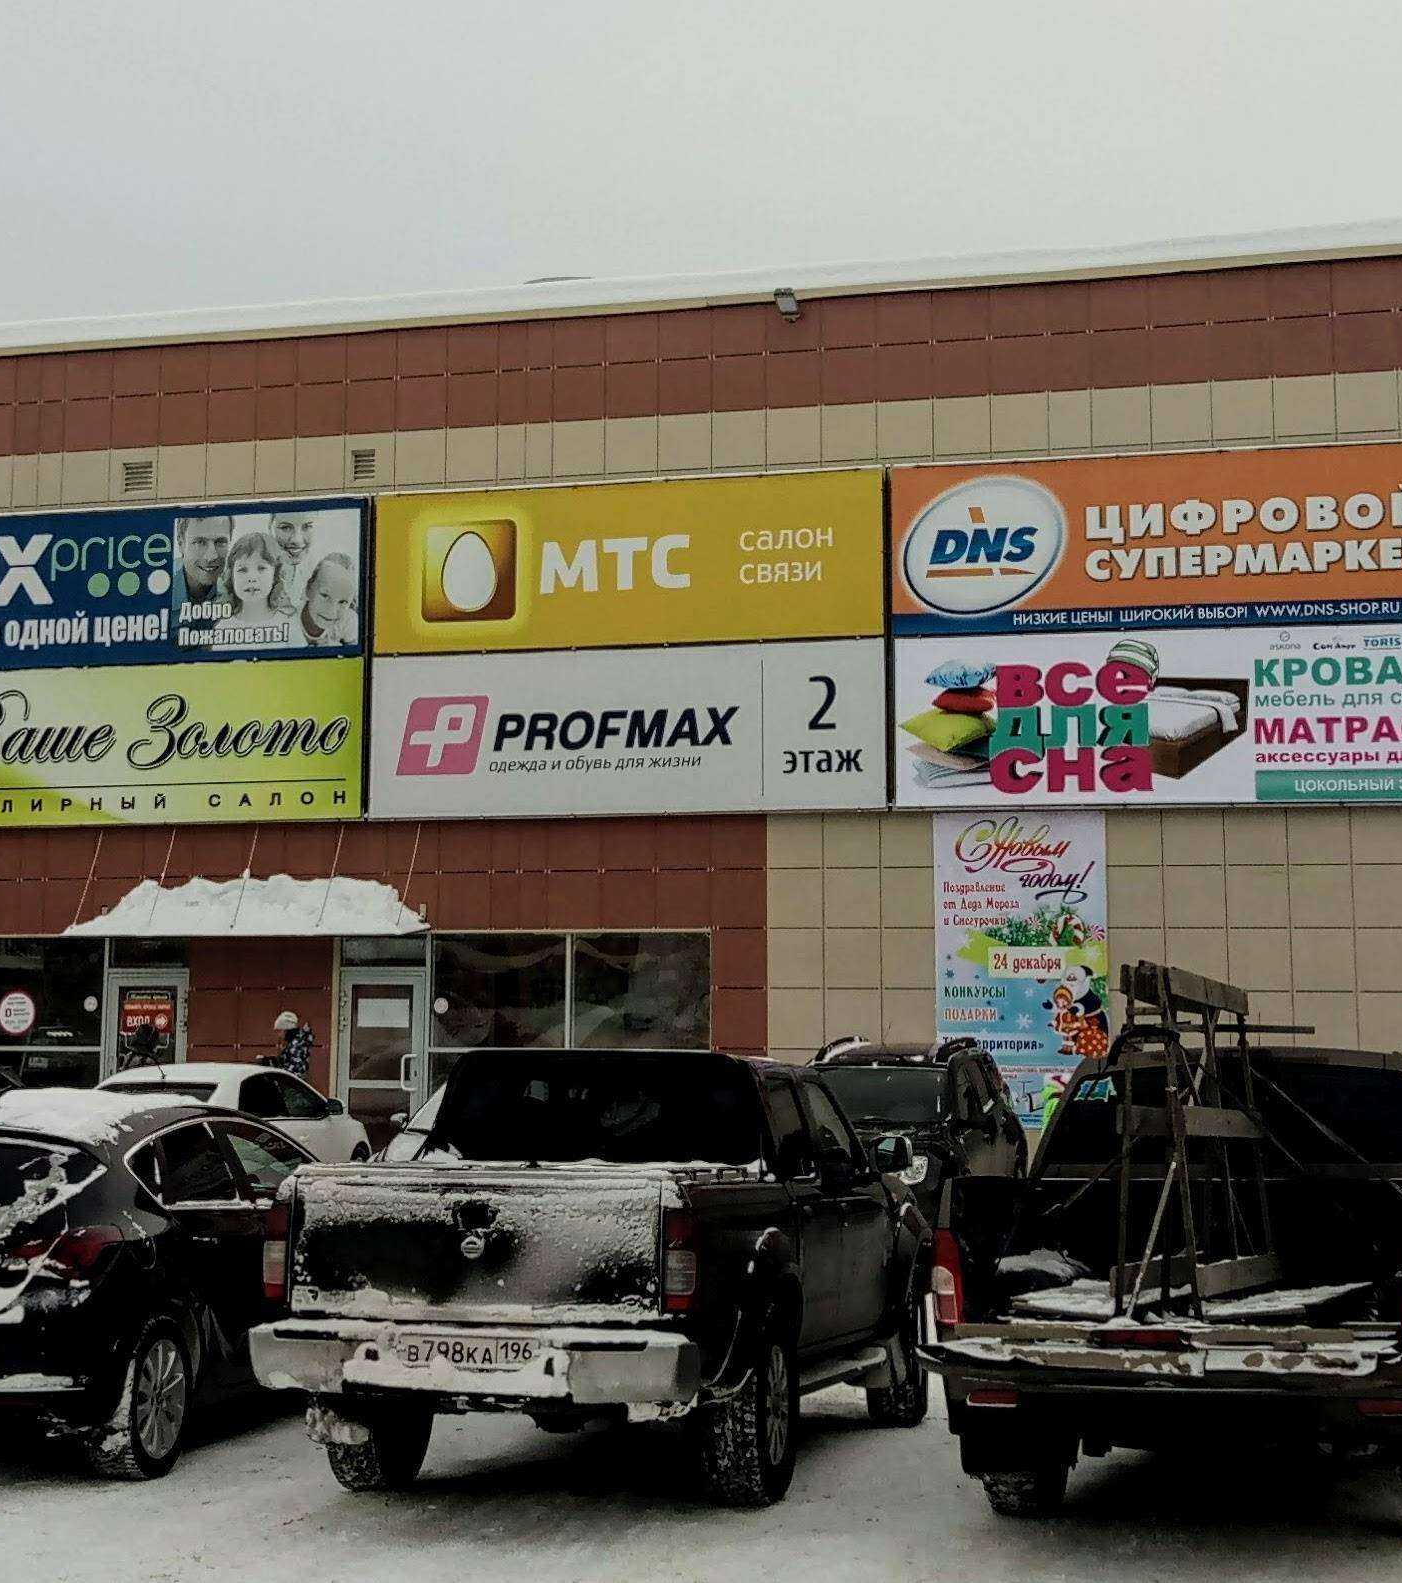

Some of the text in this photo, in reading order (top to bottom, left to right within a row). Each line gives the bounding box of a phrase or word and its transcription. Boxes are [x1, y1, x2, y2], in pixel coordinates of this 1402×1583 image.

[739, 526, 834, 552] салон
[929, 526, 1039, 564] DNS
[50, 533, 171, 581] price
[539, 534, 691, 595] МТС
[739, 559, 823, 585] связи
[179, 601, 233, 622] Добро
[1013, 611, 1068, 625] НИЗКИЕ
[1119, 606, 1194, 622] ШИРОКИЙ
[1255, 601, 1401, 617] WWW.DNS-SHOP.RU
[4, 611, 89, 650] одной
[94, 608, 170, 647] цене!
[178, 624, 290, 646] Пожаловать!
[807, 675, 837, 731] 2
[1254, 690, 1336, 709] мебель
[1341, 692, 1385, 709] для
[126, 693, 352, 770] Золото
[493, 705, 740, 752] PROFMAX
[489, 754, 702, 773] одежда и обувь для жизни
[782, 747, 864, 775] этаж
[1254, 749, 1383, 766] аксессуары
[1294, 775, 1394, 794] ЦОКОЛЬНЫЙ
[208, 790, 347, 809] САЛОН
[943, 901, 957, 910] от
[986, 898, 1020, 911] Мороза
[993, 953, 1061, 974] 24 декабря
[944, 986, 1006, 999] КОНКУРСЫ
[943, 1008, 998, 1022] ПОДАРКИ
[500, 1341, 533, 1360] 196
